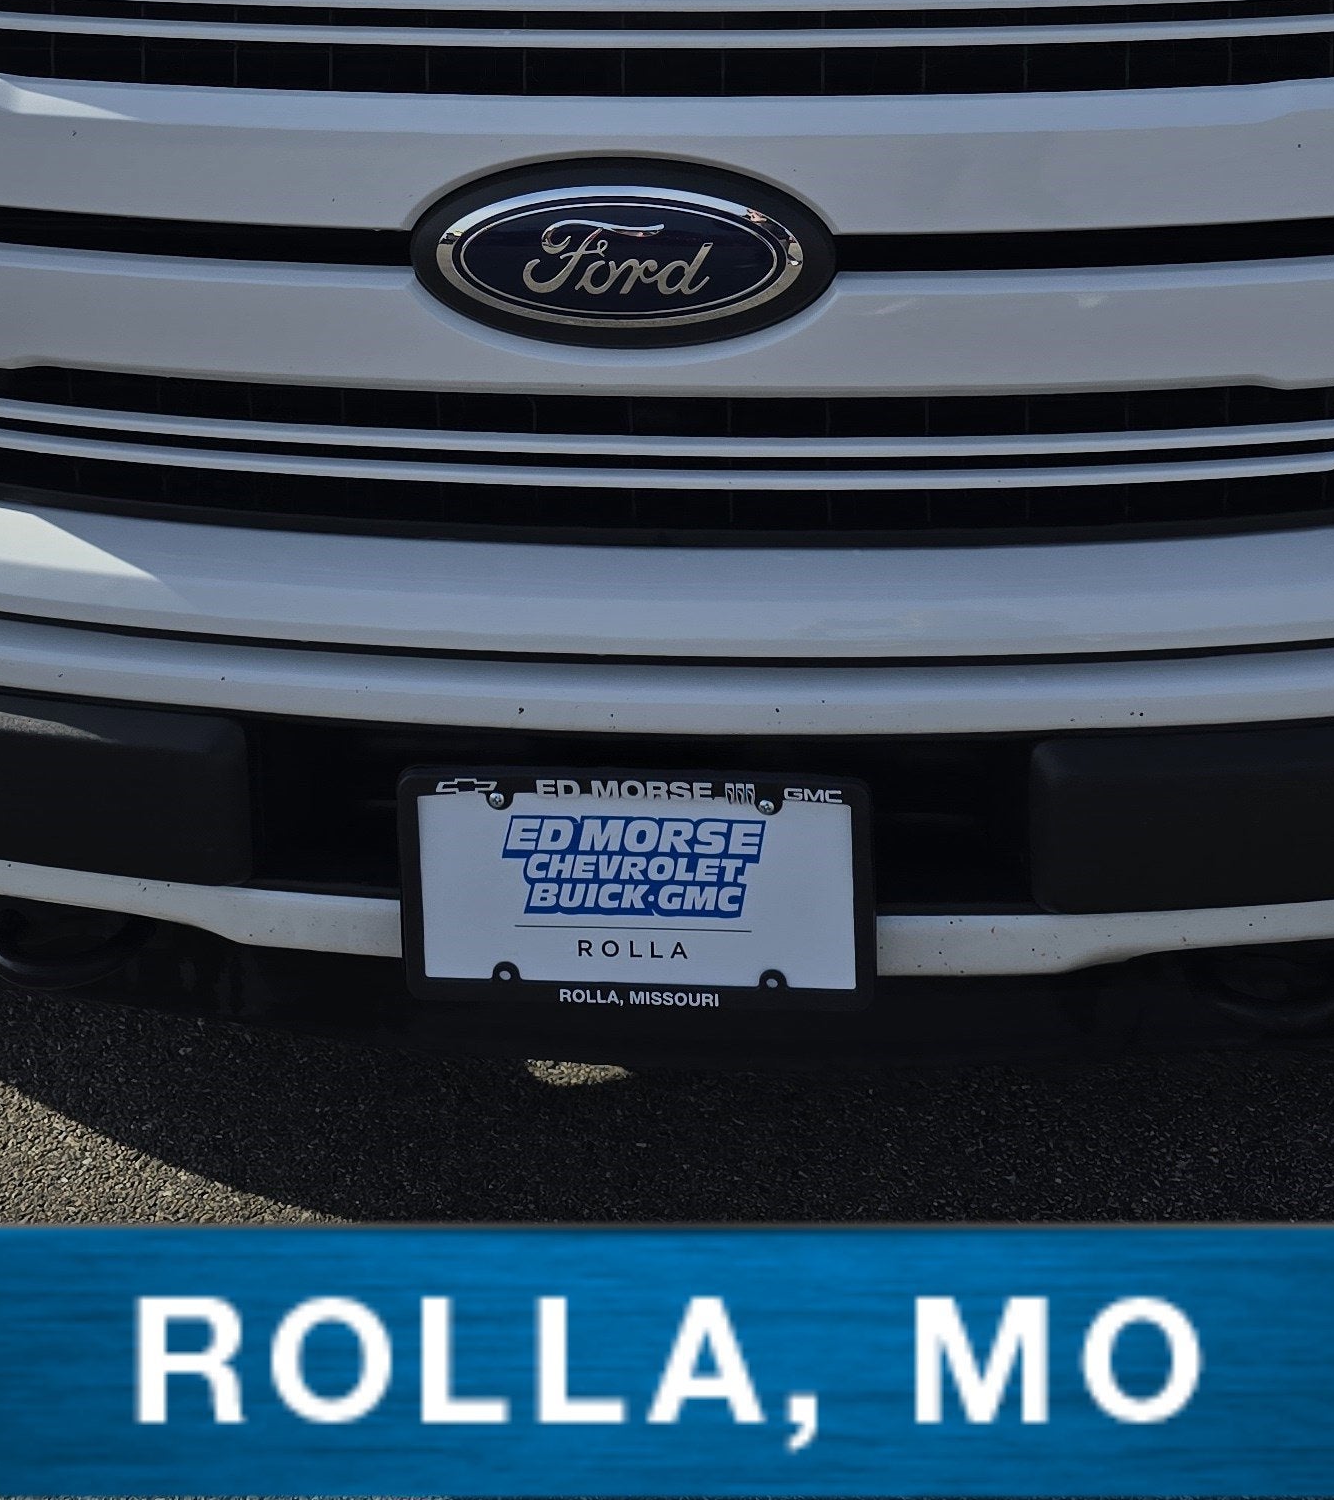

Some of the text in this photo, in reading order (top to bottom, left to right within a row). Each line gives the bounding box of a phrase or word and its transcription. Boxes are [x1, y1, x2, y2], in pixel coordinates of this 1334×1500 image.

[522, 219, 714, 295] Ford
[535, 779, 713, 800] ED MORSE
[783, 787, 843, 804] GMC
[505, 817, 763, 855] ED MORSE
[525, 853, 745, 883] CHEVROLET
[577, 939, 689, 960] ROLLA
[558, 988, 720, 1008] ROLLA, MISSOURI
